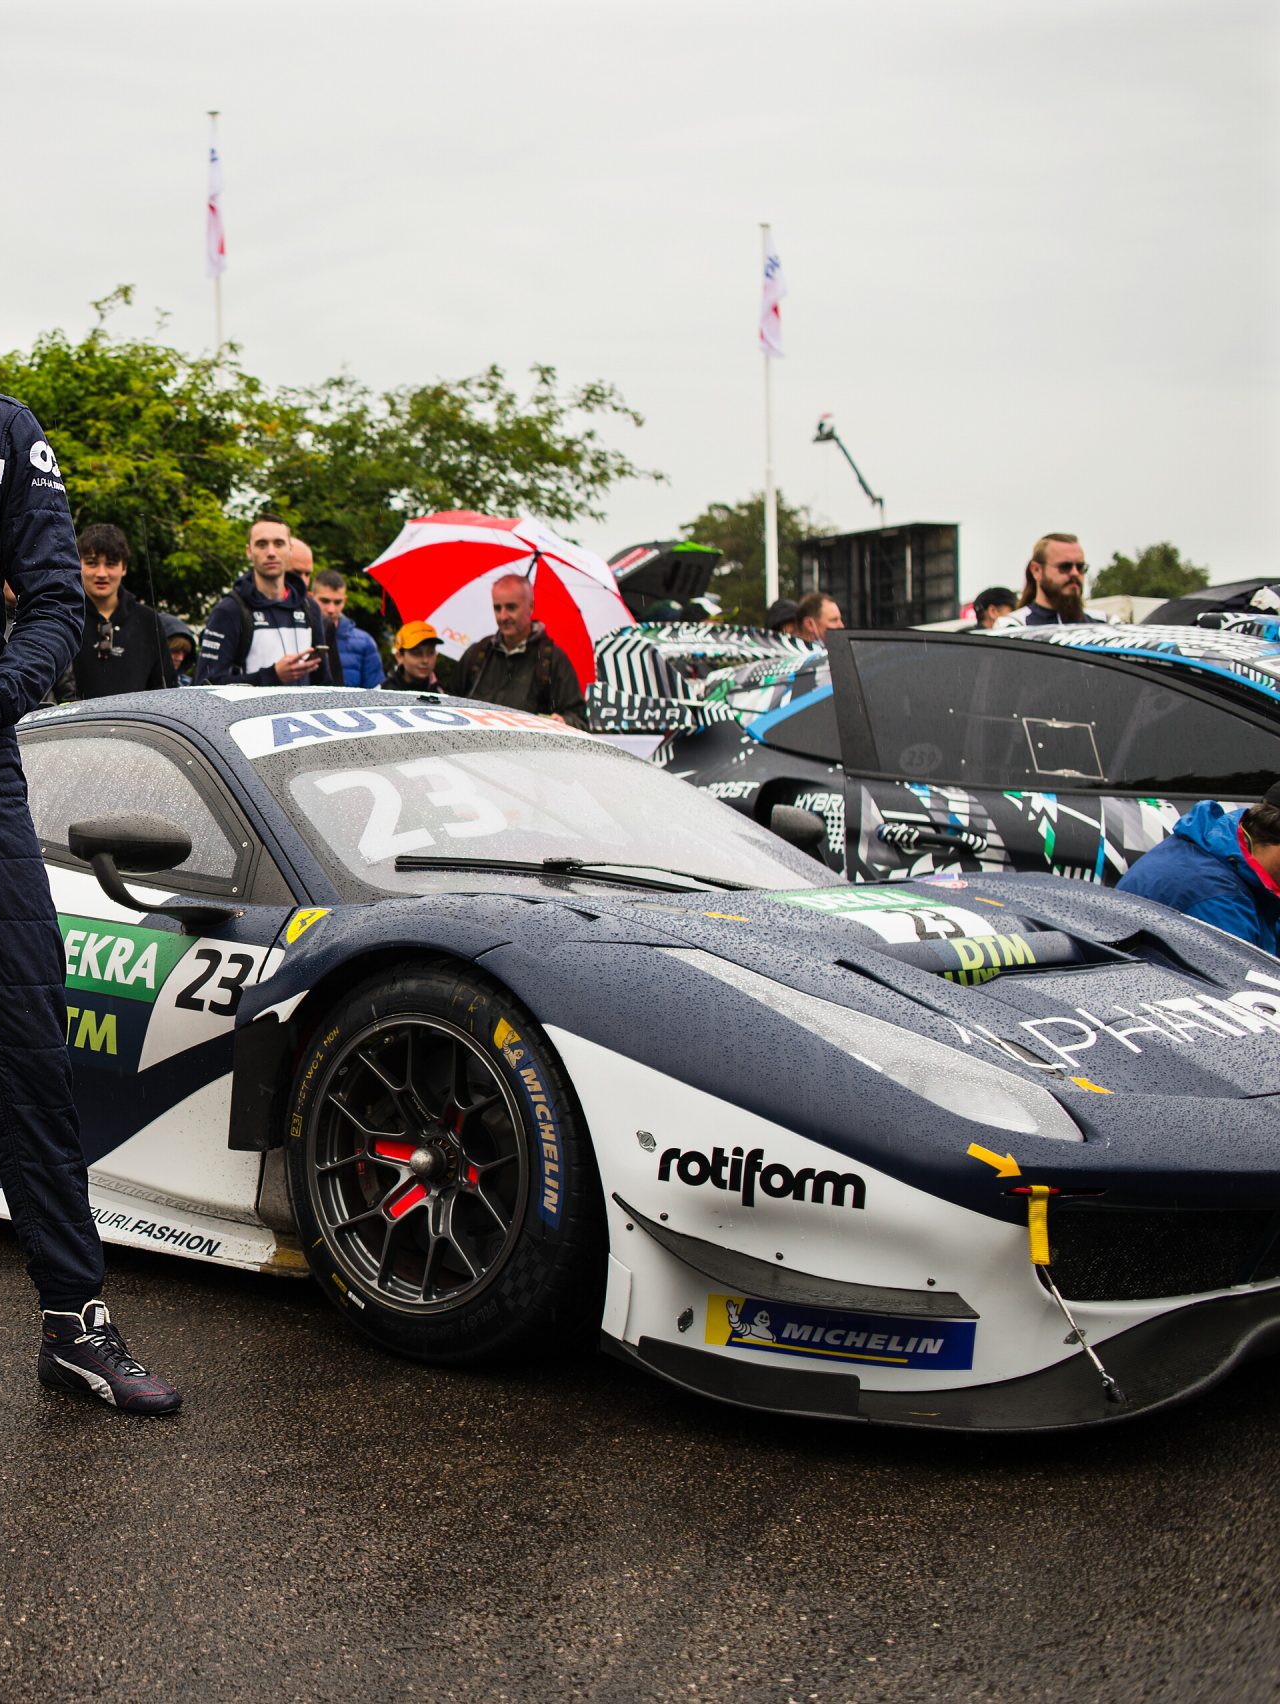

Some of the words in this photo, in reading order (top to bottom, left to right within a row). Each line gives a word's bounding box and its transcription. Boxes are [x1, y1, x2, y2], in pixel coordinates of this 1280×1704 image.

[600, 707, 681, 721] PUMA
[313, 757, 508, 864] 23
[881, 907, 967, 941] 23
[64, 929, 158, 989] EKRA
[949, 934, 1036, 970] DTM
[174, 948, 255, 1017] 23
[520, 1068, 559, 1214] MICHELIN
[658, 1146, 866, 1209] rotiform
[89, 1207, 221, 1256] AURI.FASHION
[781, 1322, 944, 1354] MICHELIN
